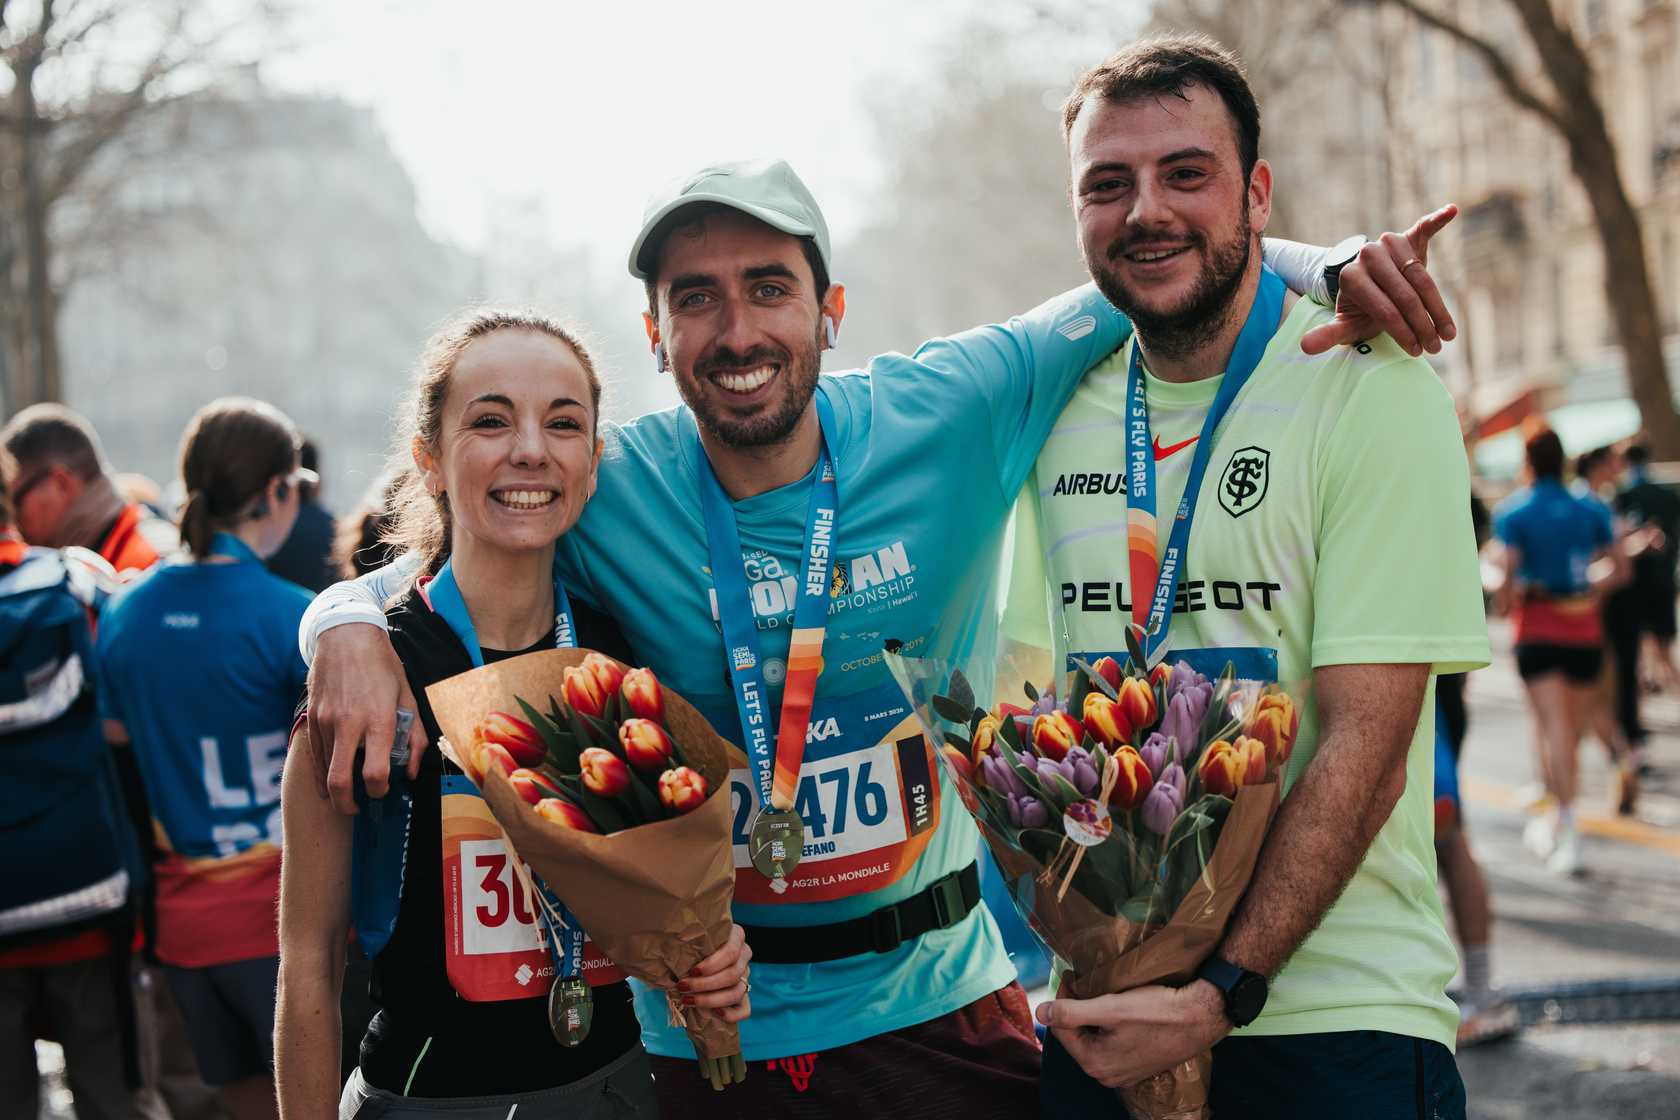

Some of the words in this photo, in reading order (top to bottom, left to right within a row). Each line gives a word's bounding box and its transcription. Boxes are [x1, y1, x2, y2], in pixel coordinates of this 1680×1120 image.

[1131, 421, 1146, 447] FLY
[1132, 450, 1147, 498] PARIS
[805, 508, 834, 597] FINISHER
[556, 612, 573, 648] FINI
[840, 651, 886, 672] OCTOBE
[742, 681, 763, 725] LET'S
[752, 728, 768, 755] FLY
[758, 759, 773, 806] PARIS
[911, 784, 928, 827] 1H45
[792, 878, 820, 888] AG2R
[822, 875, 837, 885] LA
[837, 862, 891, 882] MONDIALE
